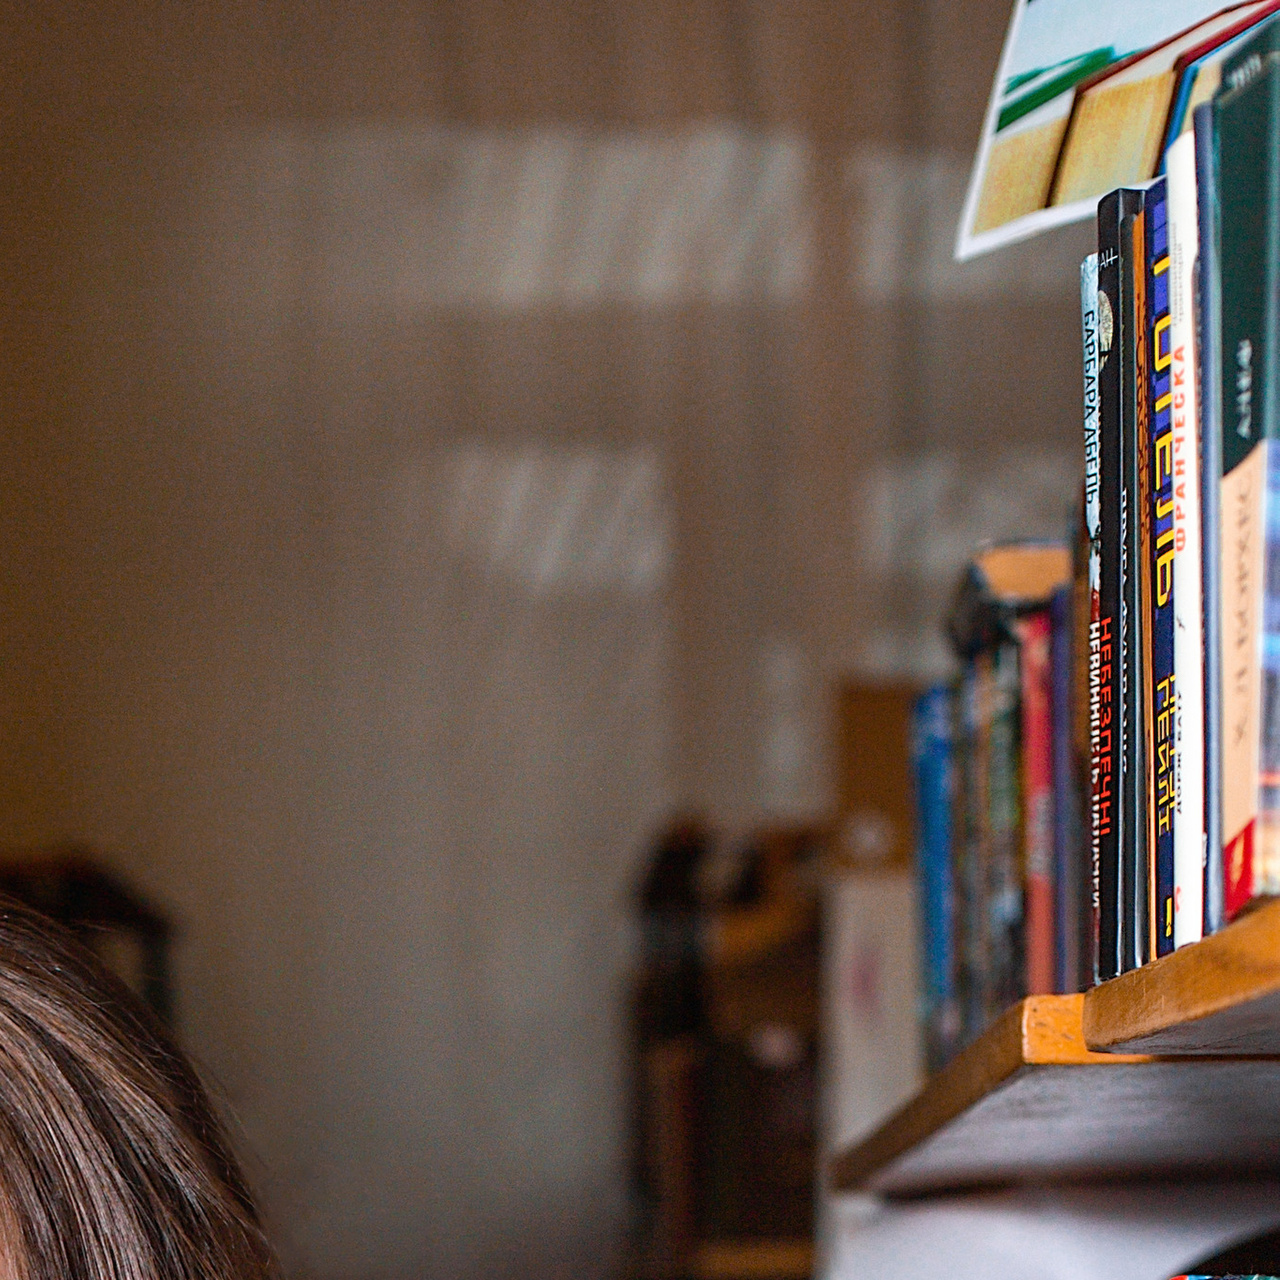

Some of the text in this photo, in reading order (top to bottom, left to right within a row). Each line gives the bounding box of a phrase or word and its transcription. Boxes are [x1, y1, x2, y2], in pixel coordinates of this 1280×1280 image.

[1084, 310, 1099, 505] БАРБАРА АБЕЛЬ
[1174, 342, 1187, 555] ФРАНЧЕСКА
[1100, 617, 1112, 837] НЕБЕЗПЕЧНІ
